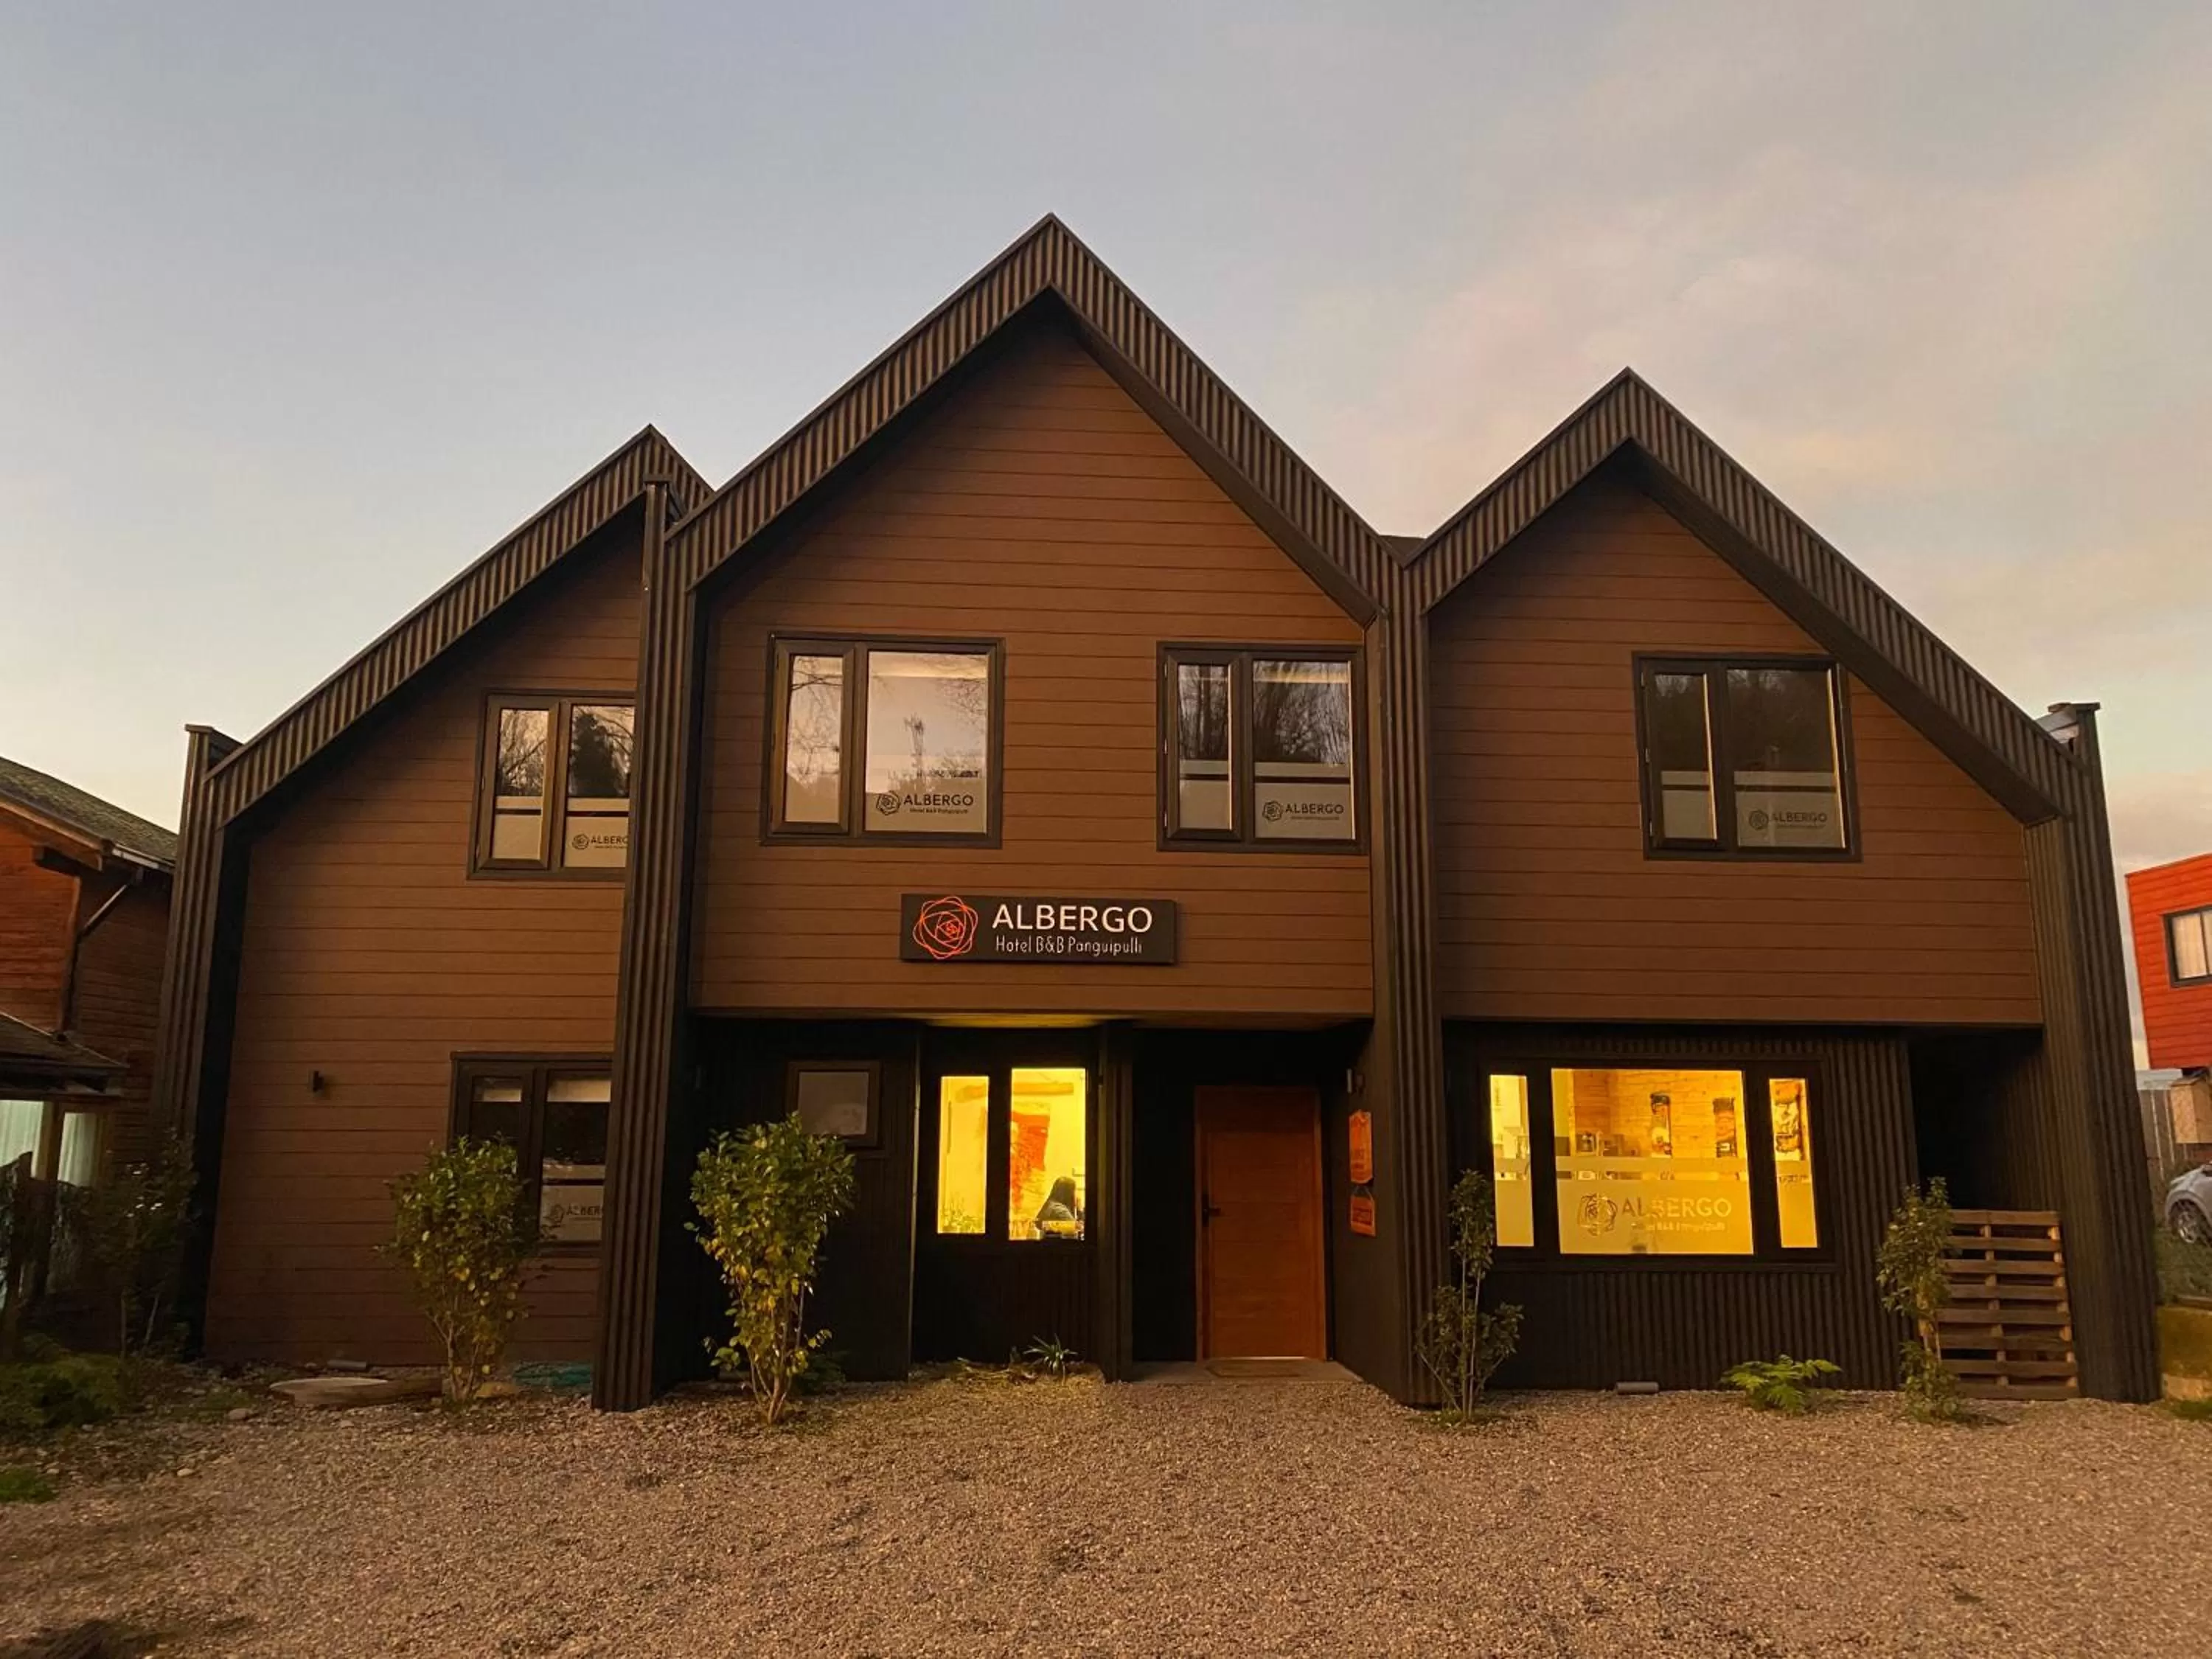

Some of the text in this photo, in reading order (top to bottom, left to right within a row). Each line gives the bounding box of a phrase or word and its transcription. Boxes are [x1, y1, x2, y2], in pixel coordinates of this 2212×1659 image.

[903, 794, 974, 807] ALBERGO
[1285, 804, 1344, 814] ALBERGO
[591, 835, 629, 844] ALBERG
[992, 904, 1152, 933] ALBERGO
[996, 936, 1143, 957] Hotel B&B Panguipulli
